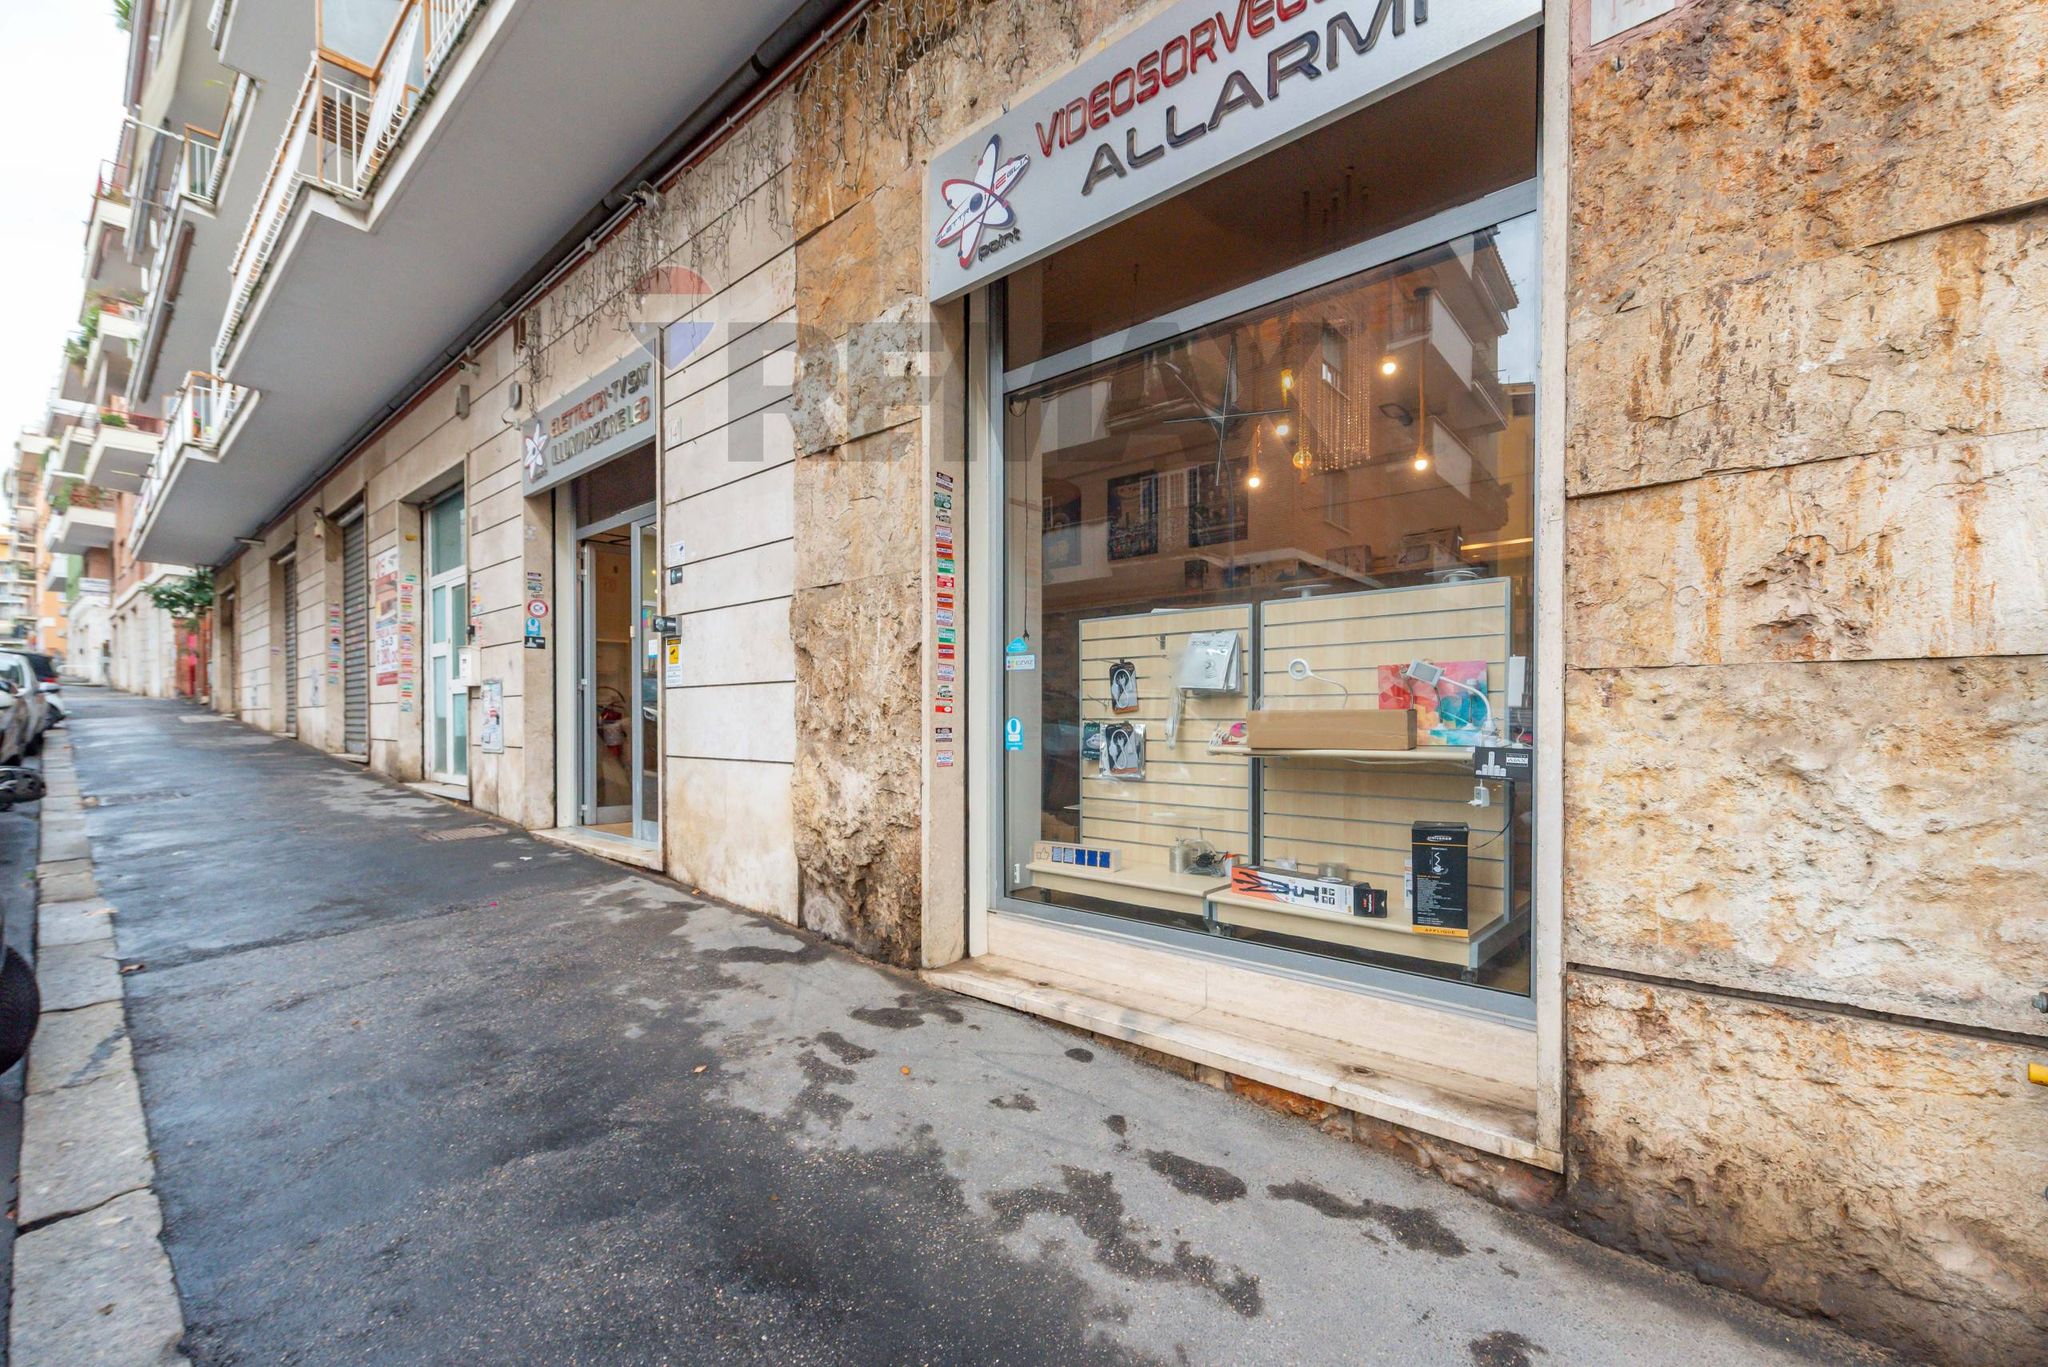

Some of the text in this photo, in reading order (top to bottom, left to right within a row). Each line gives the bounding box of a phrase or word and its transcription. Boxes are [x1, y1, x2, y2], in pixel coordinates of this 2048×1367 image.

[1035, 0, 1325, 158] VIDEOSORVE
[978, 227, 1021, 262] point
[552, 408, 626, 465] ILLUMINAZIONE
[626, 396, 650, 428] LED
